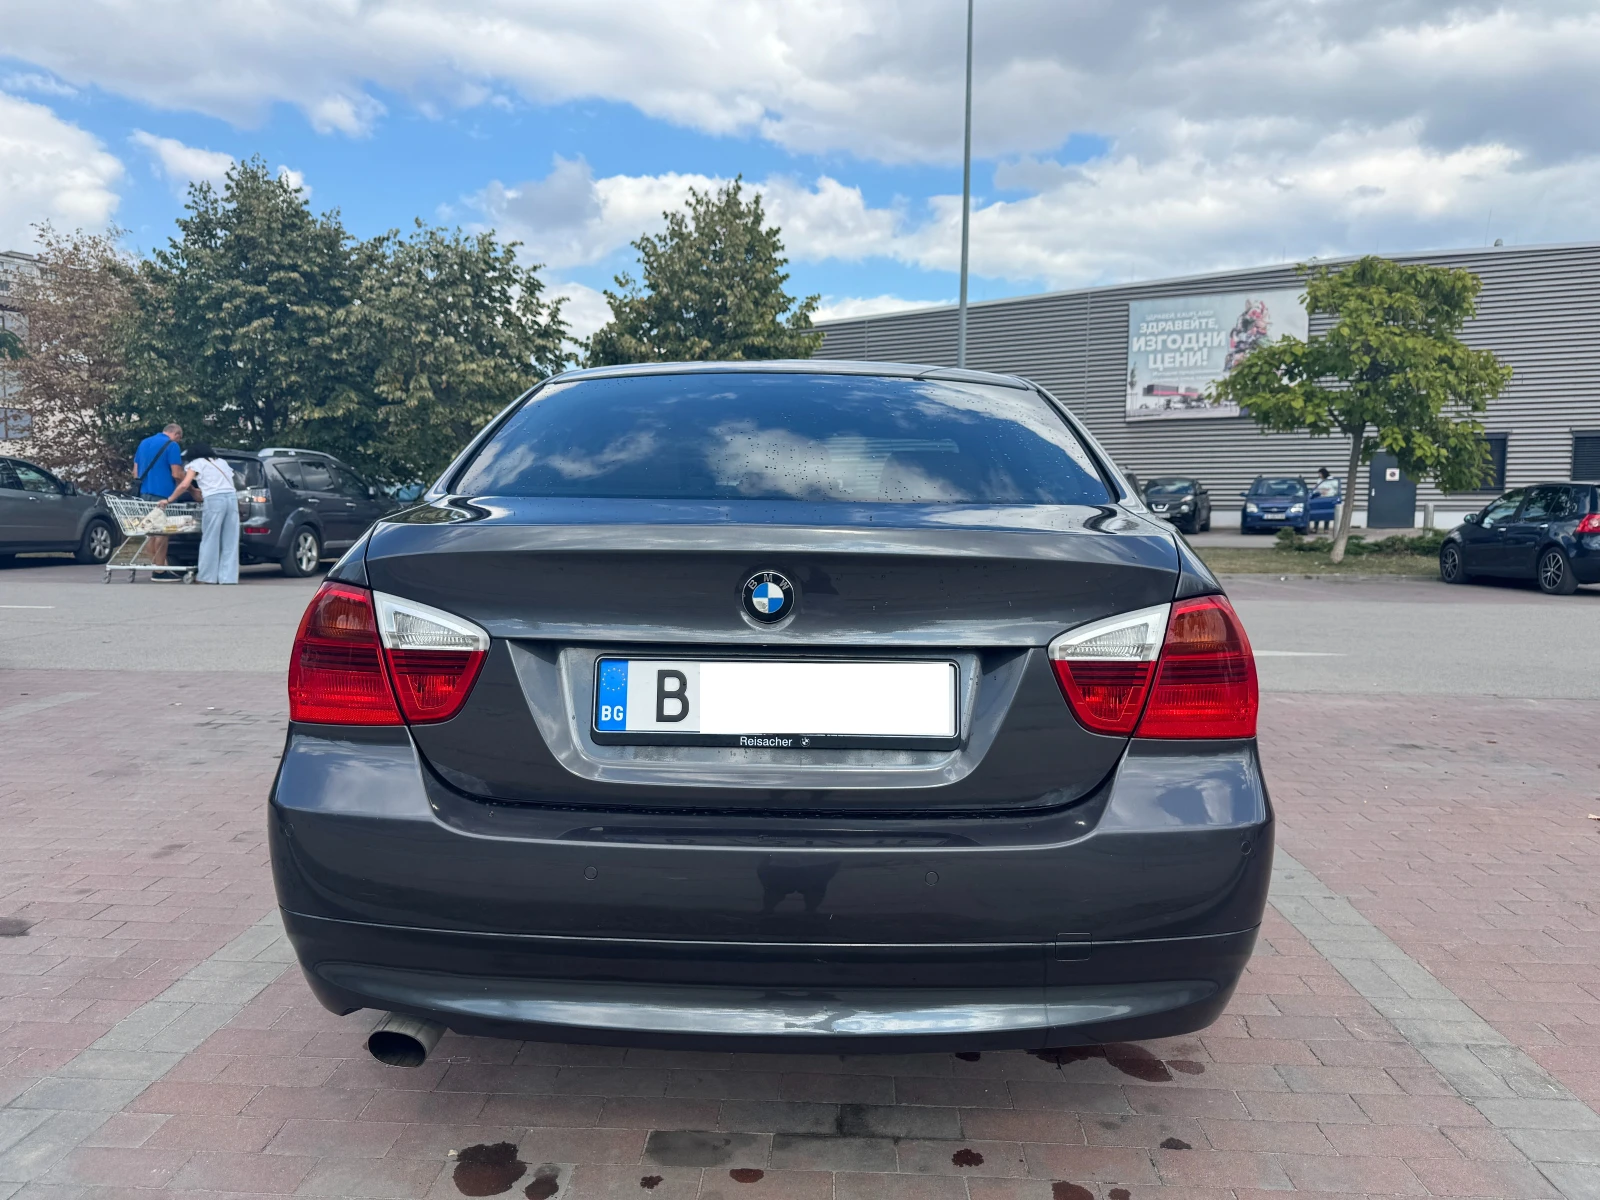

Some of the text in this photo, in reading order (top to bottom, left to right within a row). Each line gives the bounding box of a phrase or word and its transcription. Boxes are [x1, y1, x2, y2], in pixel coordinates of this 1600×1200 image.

[1139, 316, 1218, 335] ЗДРАВЕЙТЕ,
[1132, 331, 1226, 352] ИЗГОДНИ
[1148, 347, 1208, 371] ЦЕНИ!
[748, 573, 790, 590] BMW
[656, 669, 690, 723] B
[601, 705, 624, 721] BG
[740, 736, 793, 747] Reisacher
